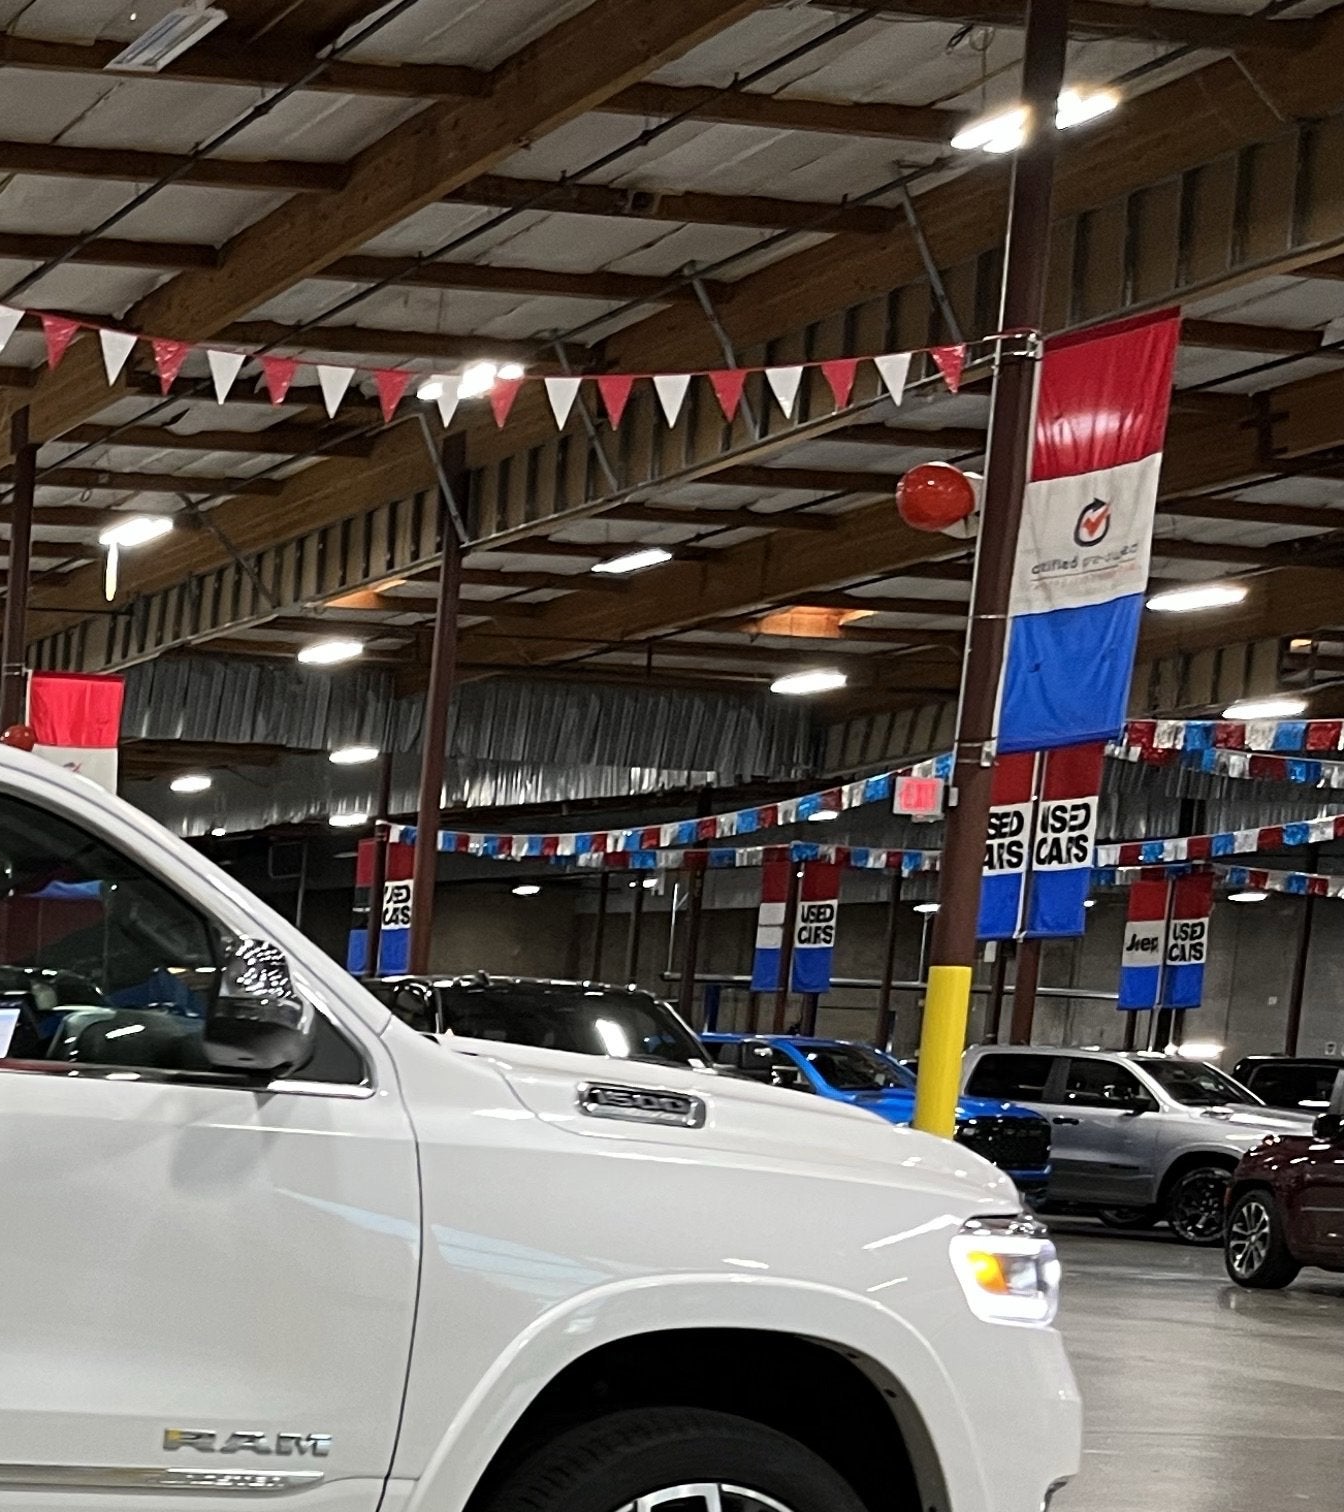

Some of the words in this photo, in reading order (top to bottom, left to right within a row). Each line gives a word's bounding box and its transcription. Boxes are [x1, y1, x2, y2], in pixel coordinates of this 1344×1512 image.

[988, 810, 1025, 840] SED
[983, 840, 1025, 870] ARS
[163, 1428, 332, 1457] RAM
